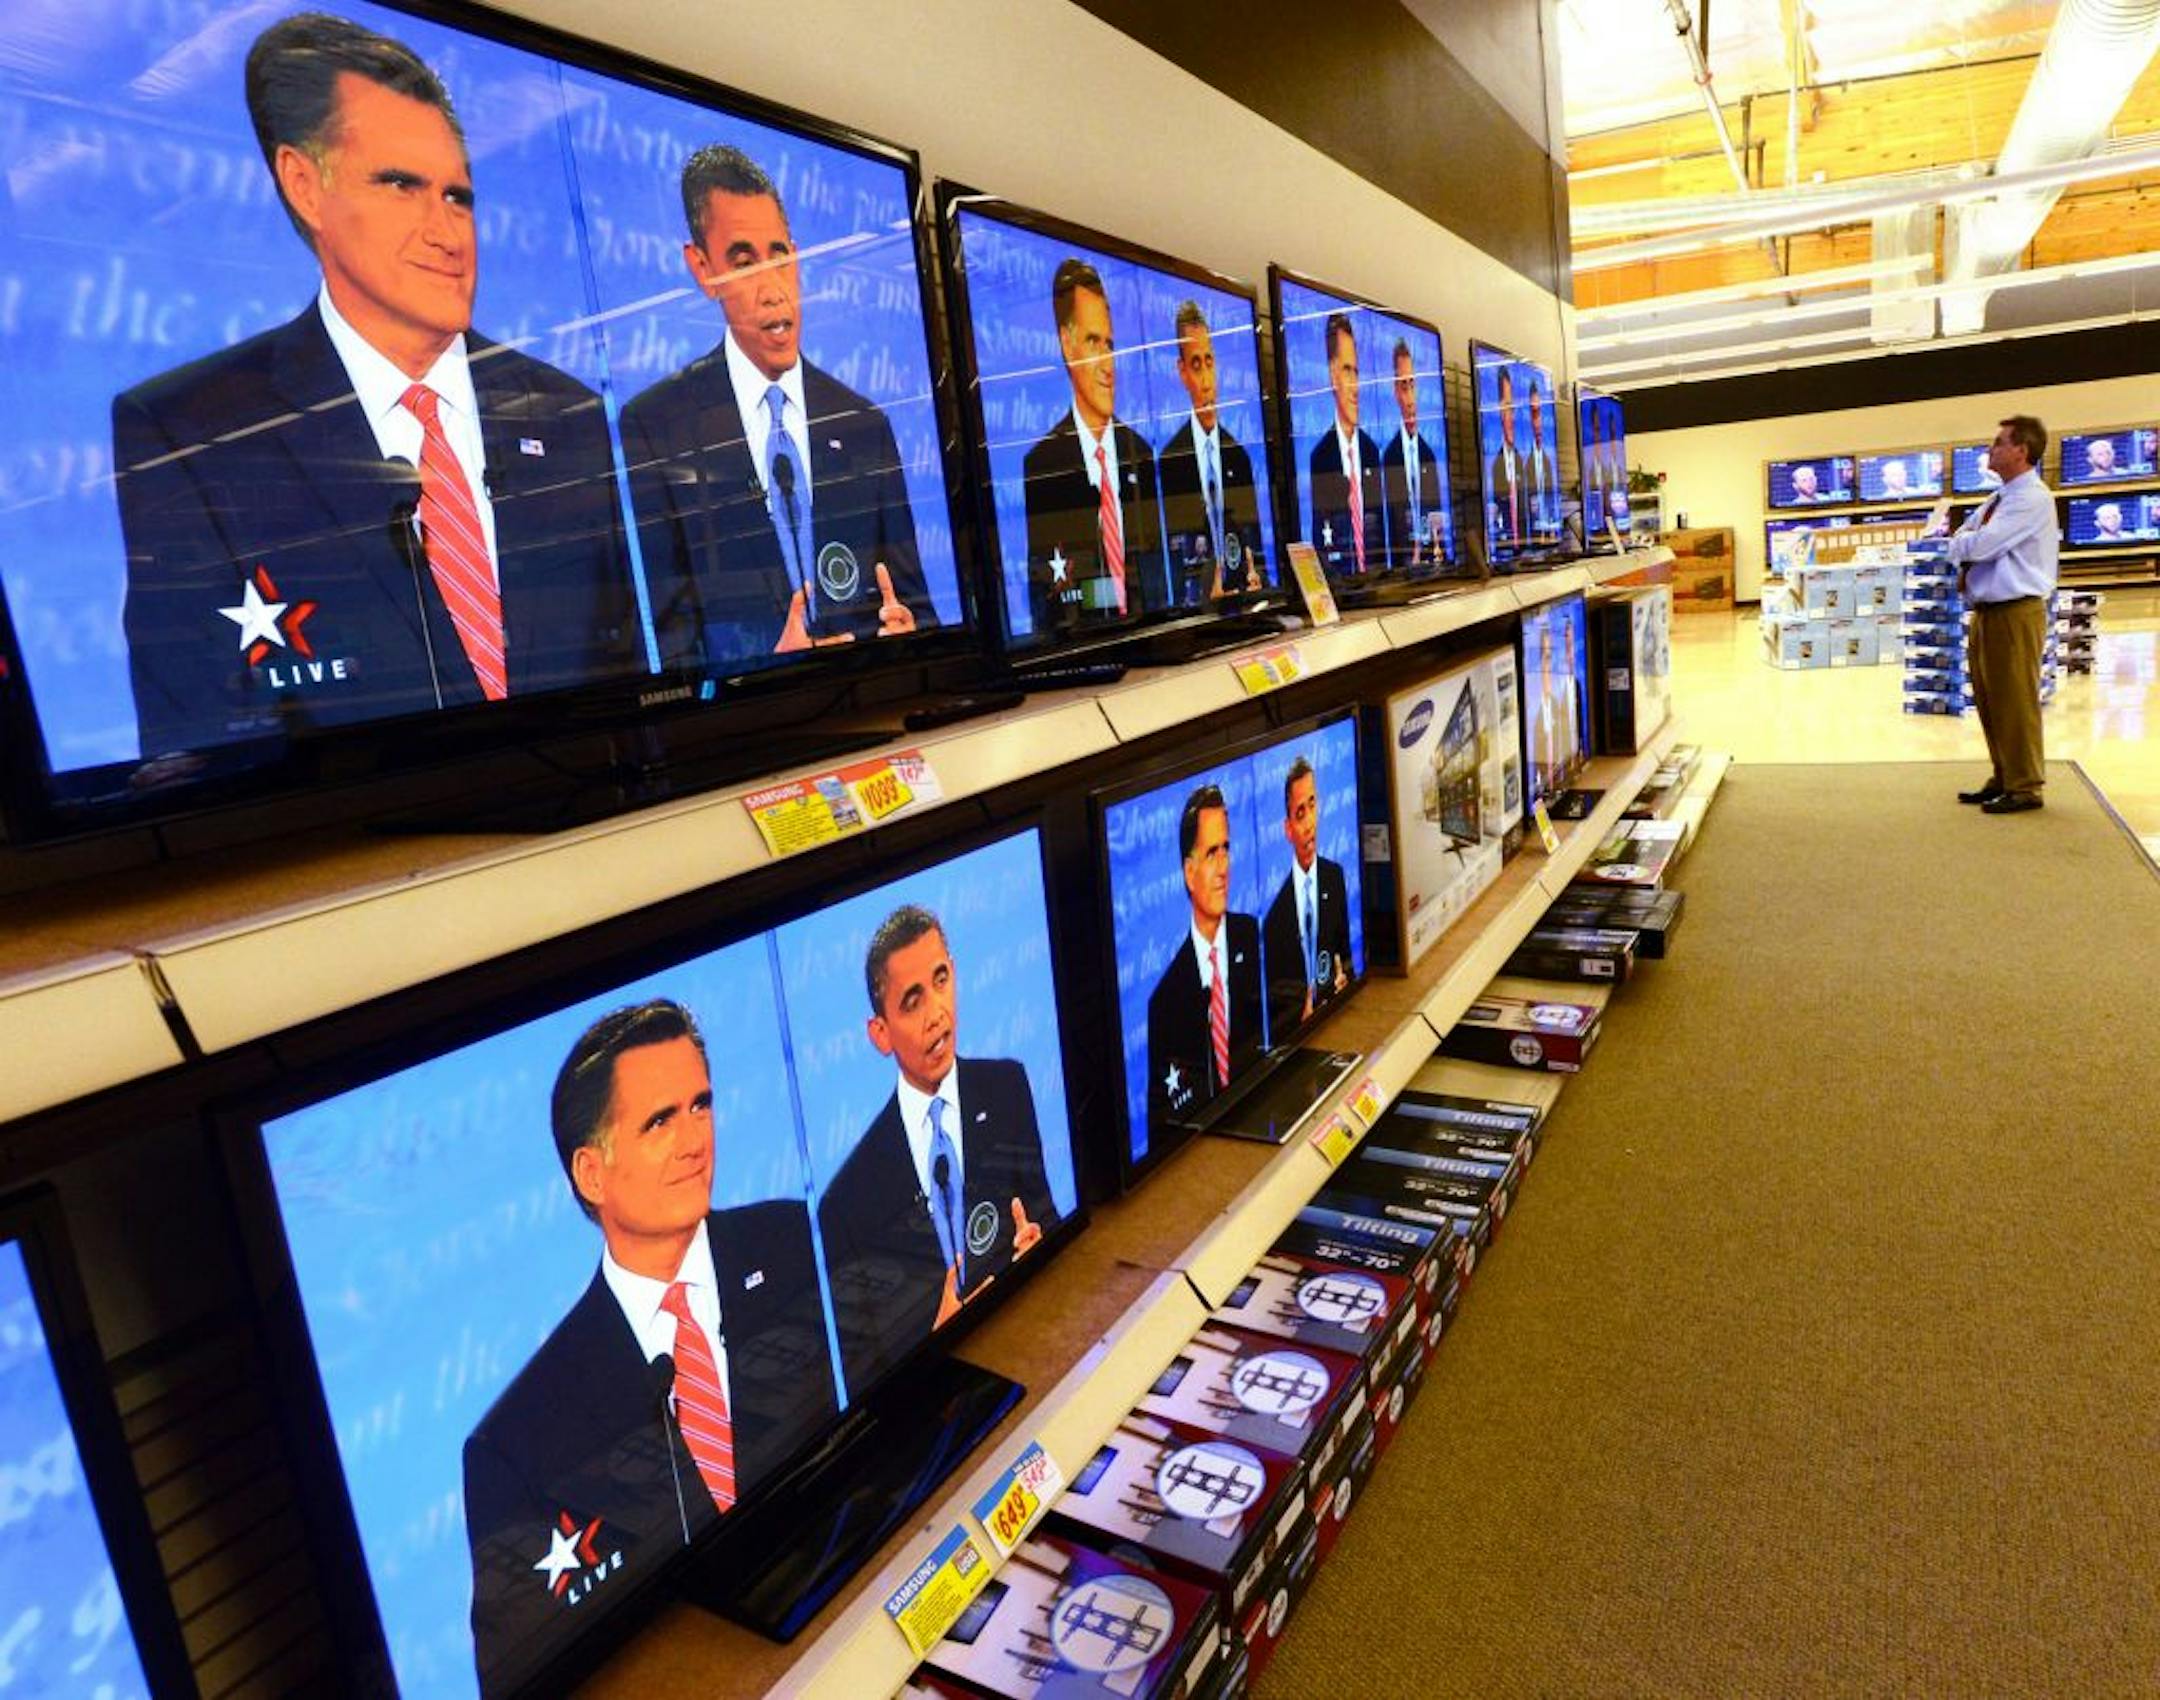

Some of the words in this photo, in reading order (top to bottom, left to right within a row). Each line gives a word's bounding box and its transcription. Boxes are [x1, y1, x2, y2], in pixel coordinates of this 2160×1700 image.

[268, 659, 347, 688] LIVE
[1424, 1158, 1491, 1178] Tilting
[1341, 1215, 1420, 1244] Tilting
[567, 1551, 623, 1605] LIVE
[888, 1560, 937, 1615] SAMSUNG
